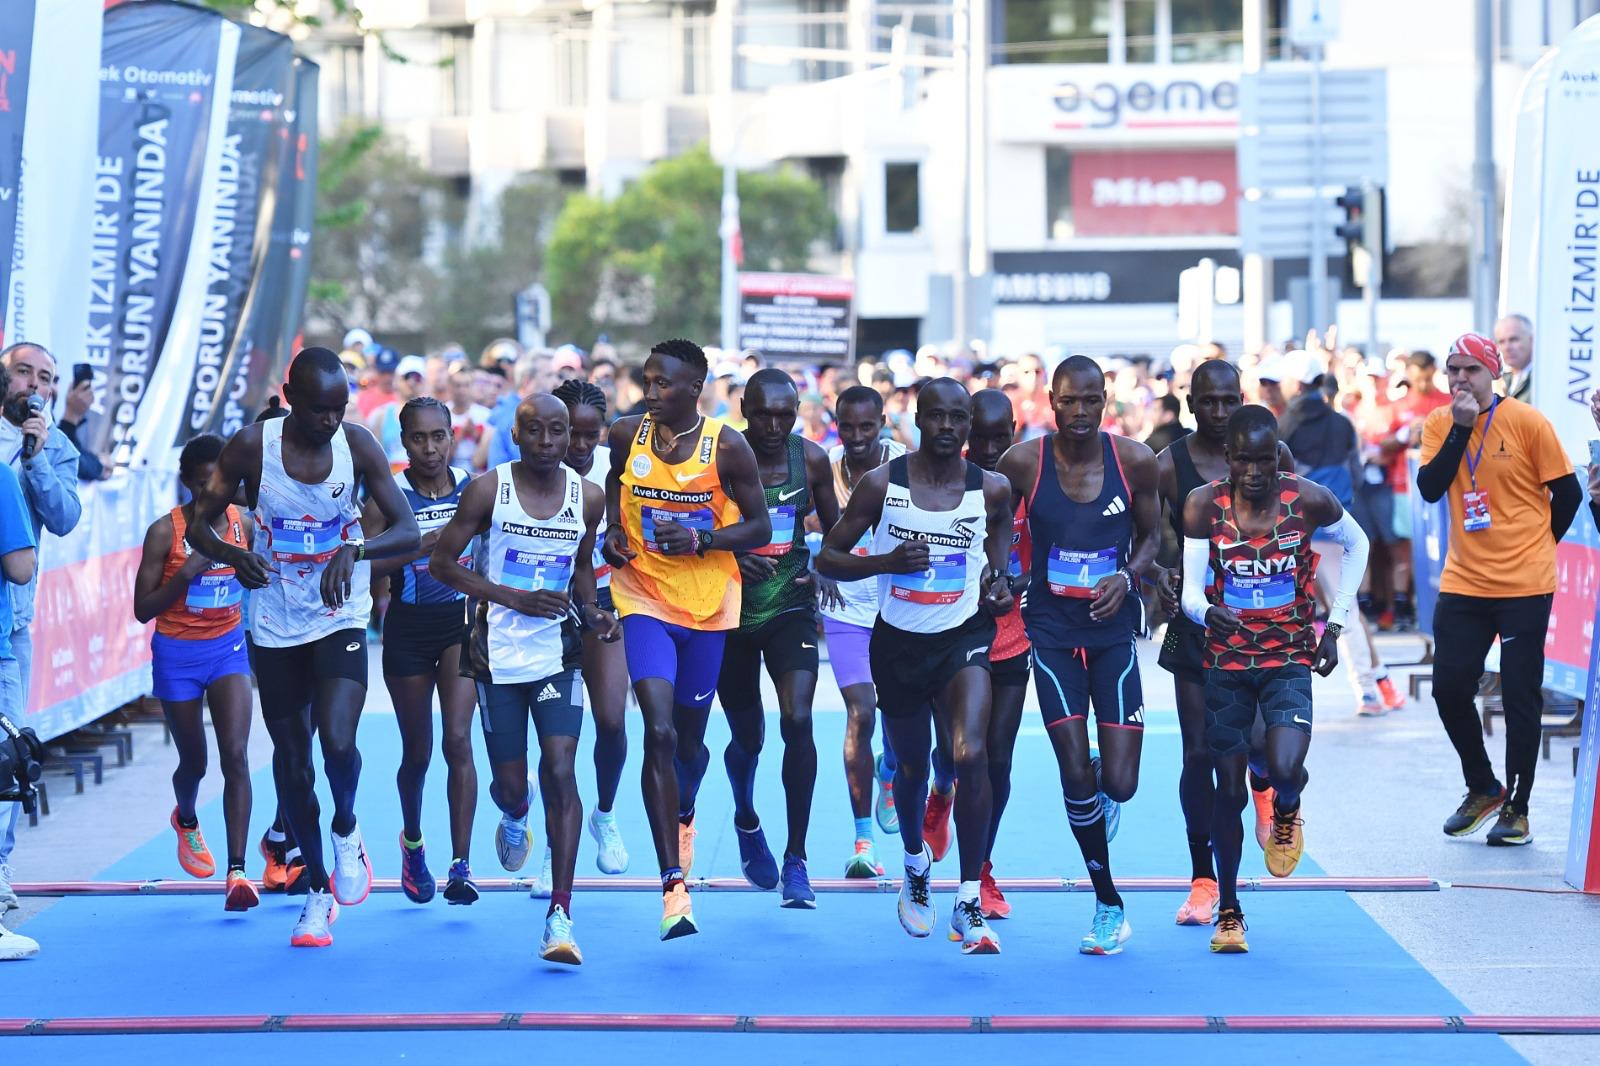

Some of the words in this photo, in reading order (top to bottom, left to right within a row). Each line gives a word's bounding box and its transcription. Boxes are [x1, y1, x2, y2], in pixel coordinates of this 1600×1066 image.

[124, 65, 212, 85] Otomotiv
[129, 118, 169, 287] YANINDA
[207, 133, 243, 284] YANINDA
[992, 272, 1111, 301] AMSUNG
[113, 295, 155, 442] SPORUN
[190, 294, 228, 431] SPORUN
[1567, 325, 1594, 406] AVEK
[638, 419, 651, 444] Avek
[701, 438, 713, 463] Avek
[633, 486, 658, 498] Avek
[660, 490, 712, 502] Otomotiv
[886, 497, 908, 508] Avek
[503, 523, 529, 535] Avek
[531, 527, 577, 540] Otomotiv
[557, 517, 578, 525] adidas
[303, 532, 315, 554] 9
[889, 526, 915, 540] Avek
[917, 532, 971, 548] Otomotiv
[1078, 564, 1089, 587] 4
[1219, 554, 1297, 576] KENYA
[532, 567, 546, 591] 5
[923, 568, 936, 591] 2
[213, 586, 229, 608] 12
[1252, 589, 1265, 608] 6
[537, 692, 562, 702] adidas
